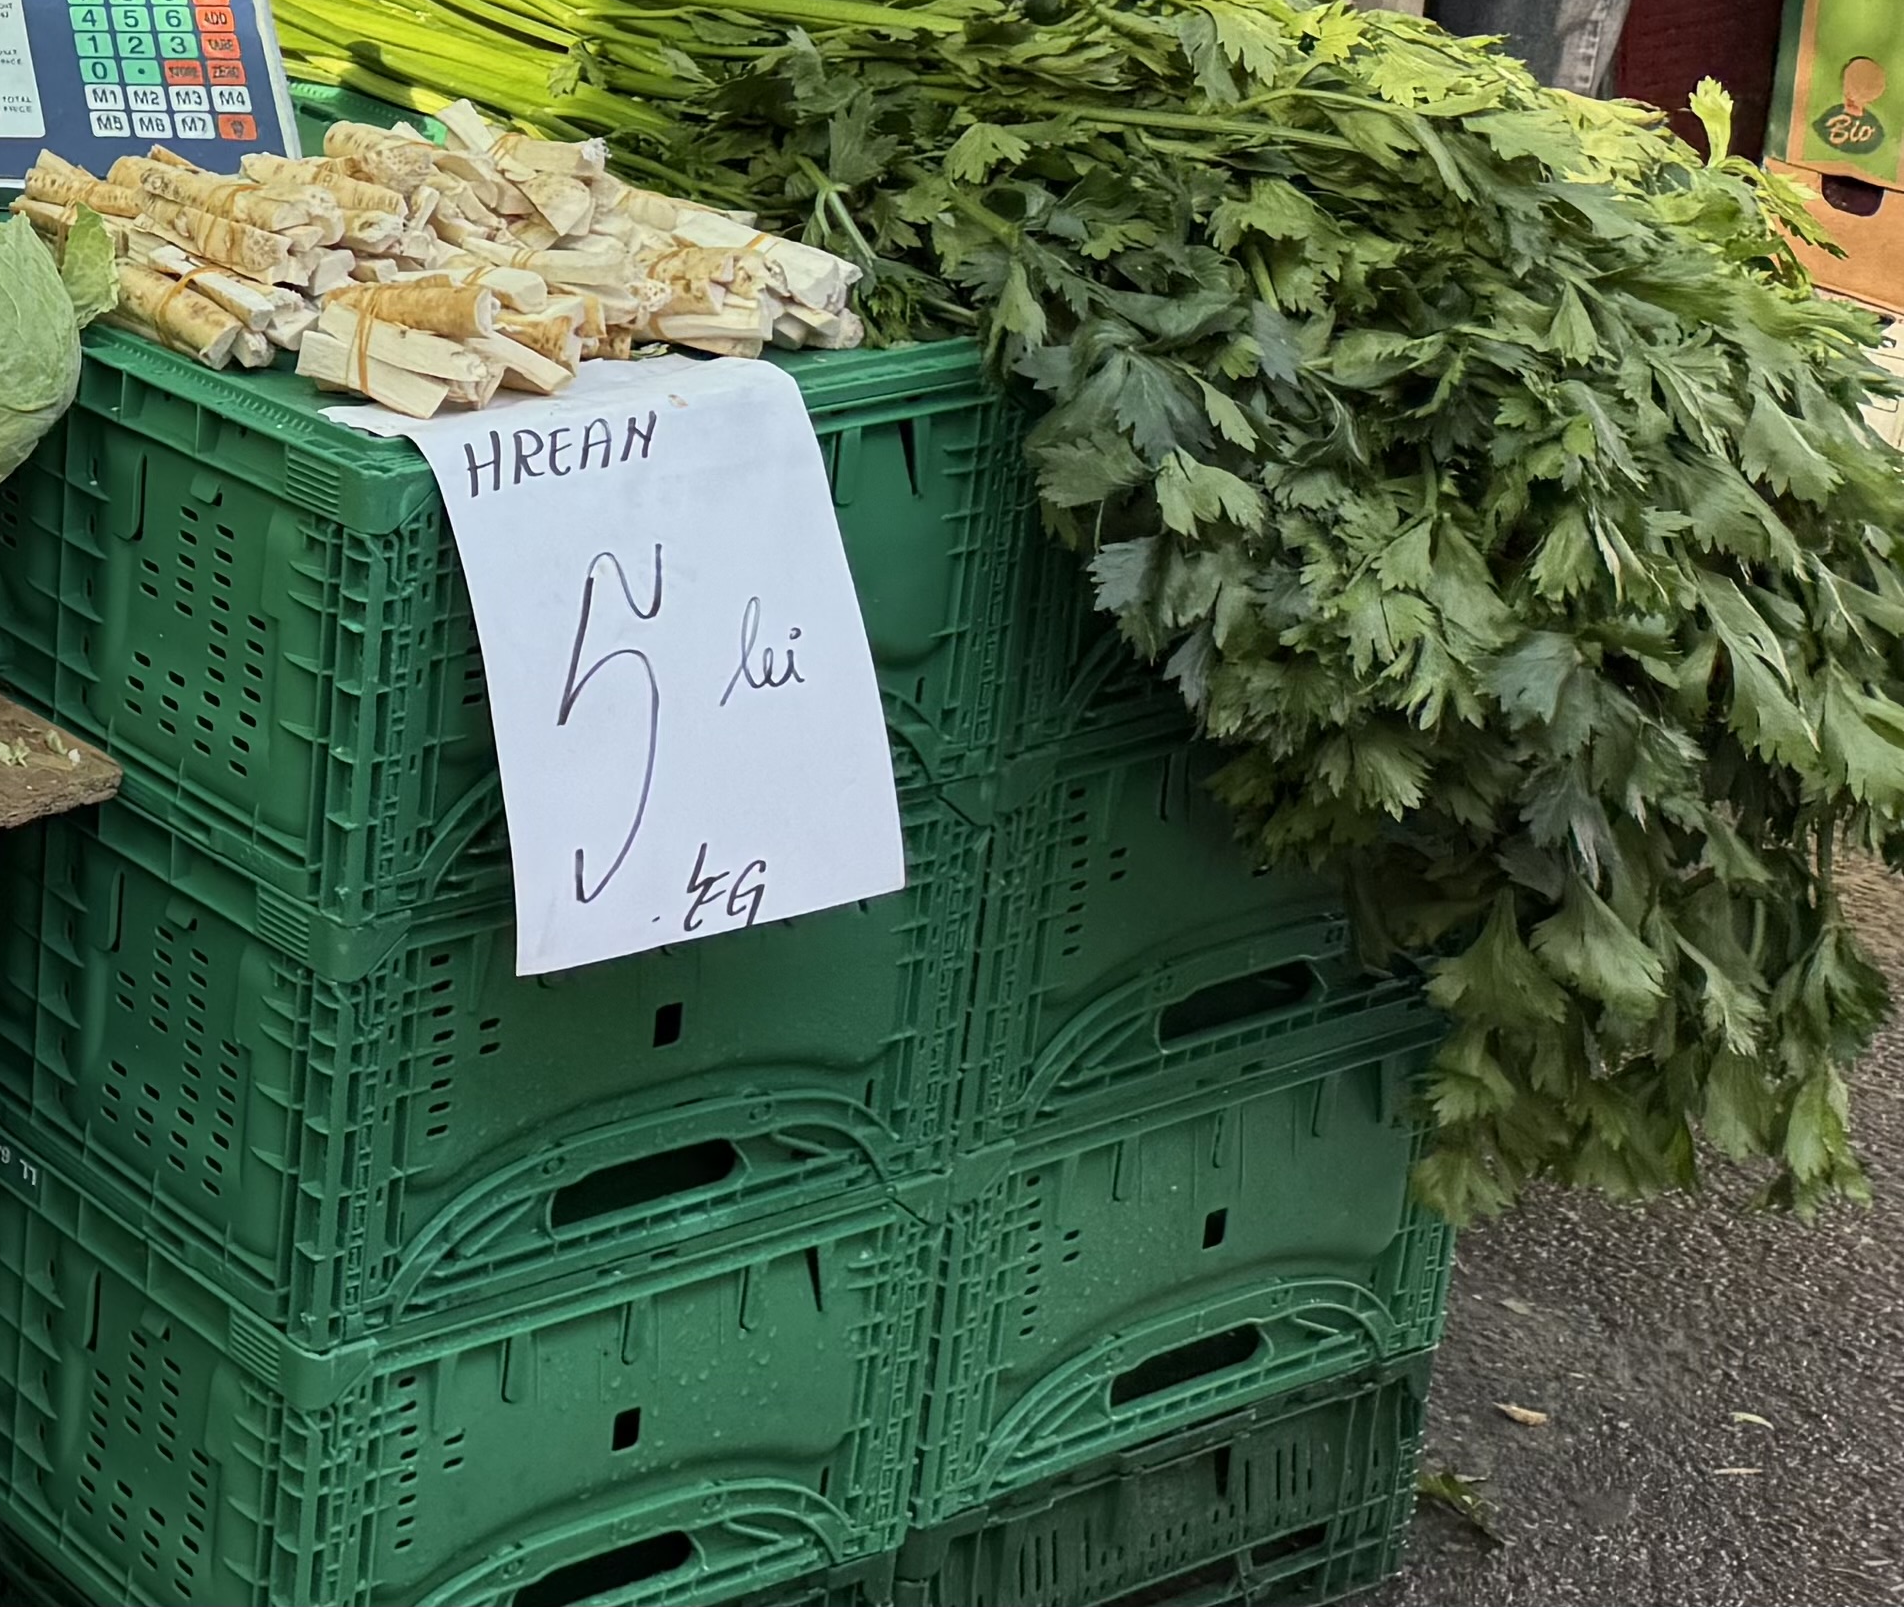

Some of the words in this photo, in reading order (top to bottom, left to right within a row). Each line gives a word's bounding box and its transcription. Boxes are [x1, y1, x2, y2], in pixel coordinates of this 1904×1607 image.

[81, 9, 97, 27] 4
[124, 10, 139, 28] 5
[166, 10, 182, 28] 6
[128, 36, 145, 54] 2
[171, 36, 187, 54] 3
[91, 61, 107, 80] 0
[92, 89, 118, 105] M1
[134, 90, 160, 106] M2
[176, 91, 203, 106] M3
[219, 91, 246, 107] M4
[181, 117, 206, 133] M7
[1825, 114, 1875, 144] Bio
[464, 411, 657, 497] HREAN
[557, 543, 662, 903] 5
[719, 596, 805, 706] lei
